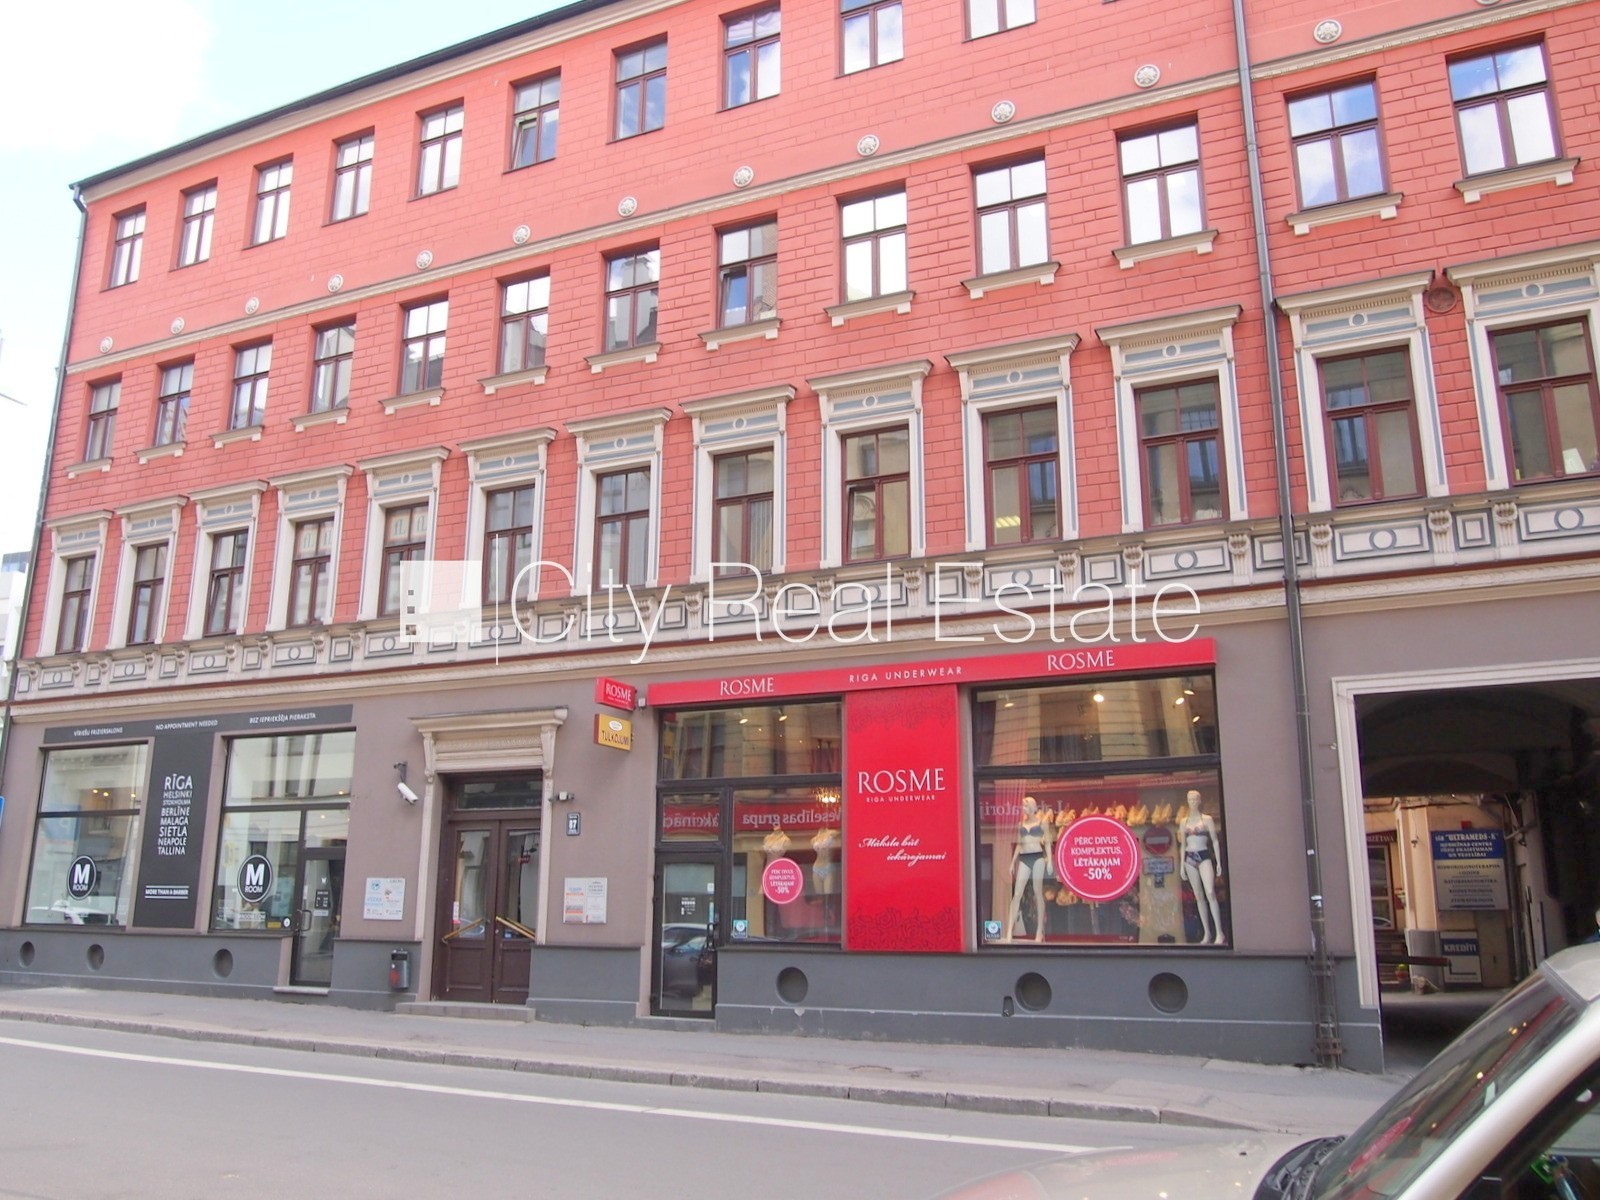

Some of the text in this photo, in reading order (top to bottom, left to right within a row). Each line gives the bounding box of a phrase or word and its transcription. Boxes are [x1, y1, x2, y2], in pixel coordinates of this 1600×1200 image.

[1047, 649, 1115, 671] ROSME
[849, 666, 962, 683] RIGA UNDERWEAR
[605, 682, 632, 702] ROSME
[720, 677, 775, 696] ROSME
[289, 712, 316, 720] PIERAKSTA
[164, 720, 198, 730] APPOINTMENT
[198, 719, 218, 727] NEEDED
[164, 774, 193, 790] RĪGA
[858, 767, 946, 794] ROSME
[163, 790, 192, 799] HELSINKI
[161, 806, 190, 816] BERLĪNE
[160, 817, 189, 826] MALAGA
[159, 826, 188, 837] SIETLA
[157, 837, 187, 846] NEAPOLE
[1074, 836, 1118, 845] PĒRC DIVUS
[158, 846, 186, 855] TALLINA
[1071, 846, 1123, 855] KOMPLEKTUS,
[1074, 857, 1121, 868] LĒTĀKAJAM
[73, 863, 91, 884] M
[245, 863, 265, 886] M
[1084, 867, 1112, 880] -50%
[245, 885, 263, 893] ROOM
